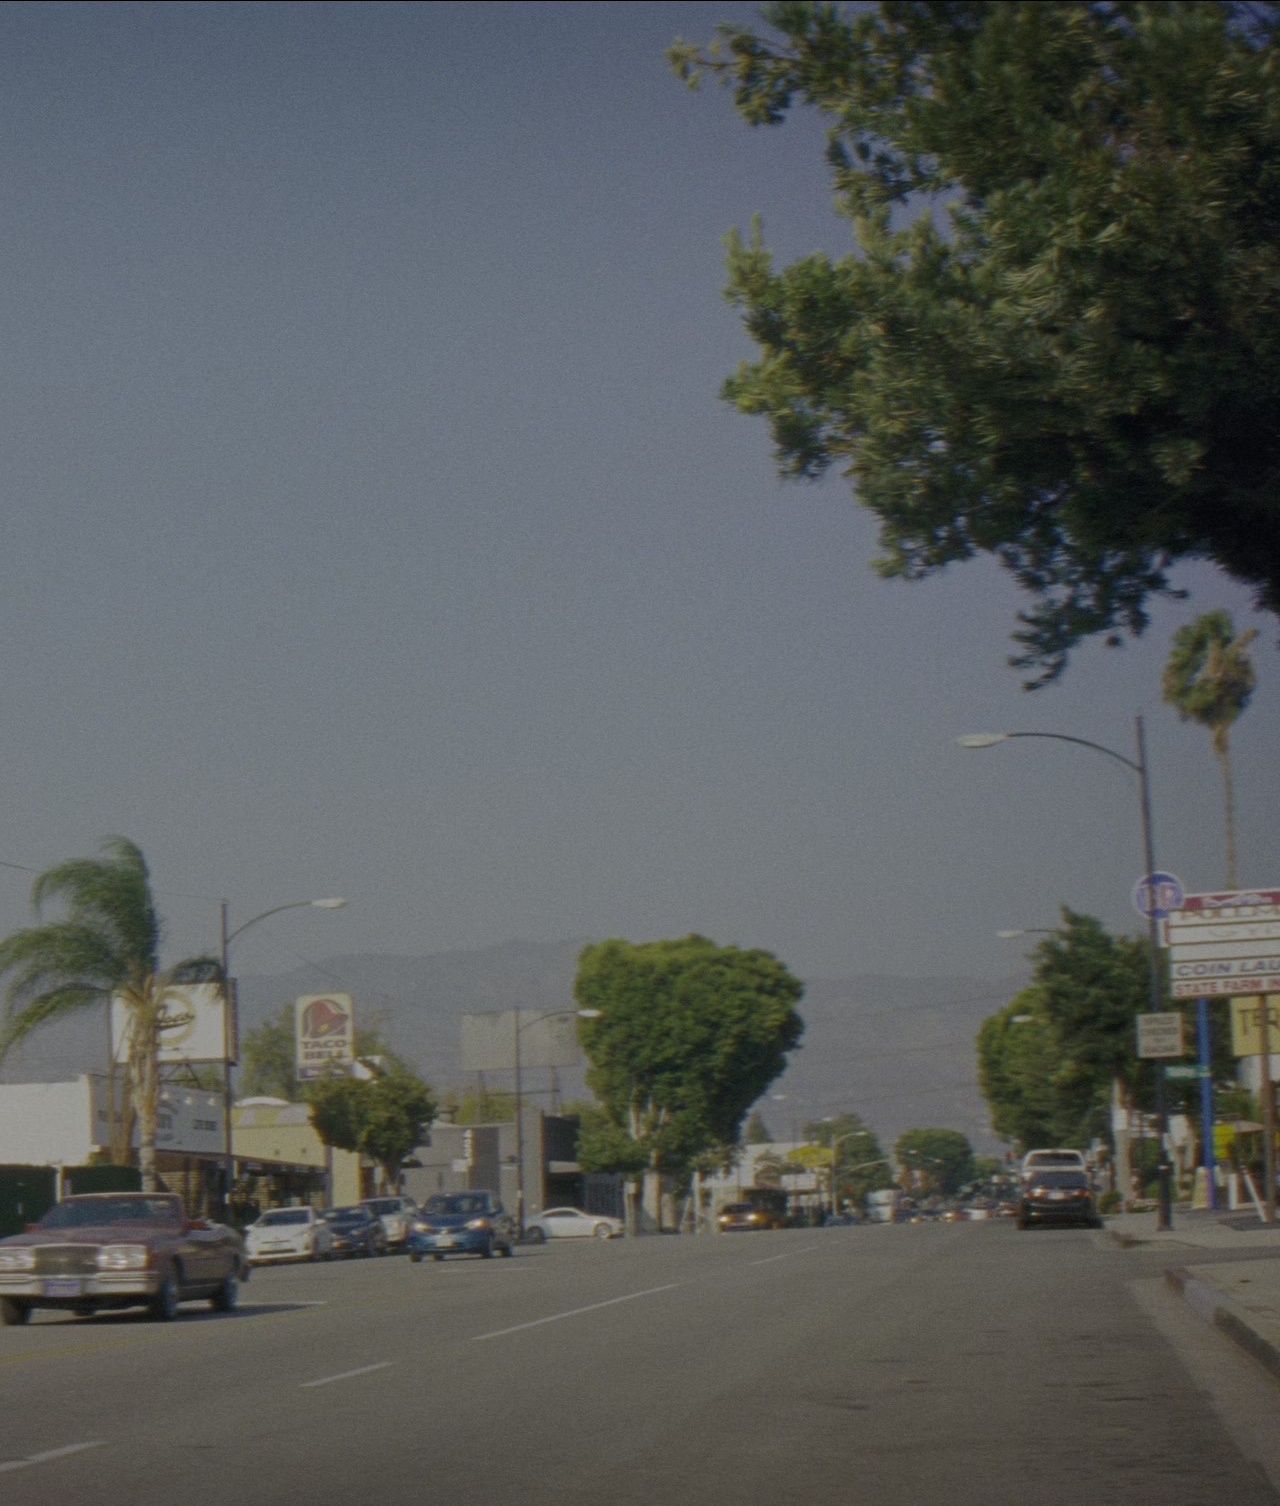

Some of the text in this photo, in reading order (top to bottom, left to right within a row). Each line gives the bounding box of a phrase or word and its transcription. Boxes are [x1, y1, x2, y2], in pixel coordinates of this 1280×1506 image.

[1176, 962, 1232, 977] COIN
[1175, 981, 1219, 995] STATE
[1223, 978, 1262, 991] FARM
[302, 1039, 347, 1050] TACO
